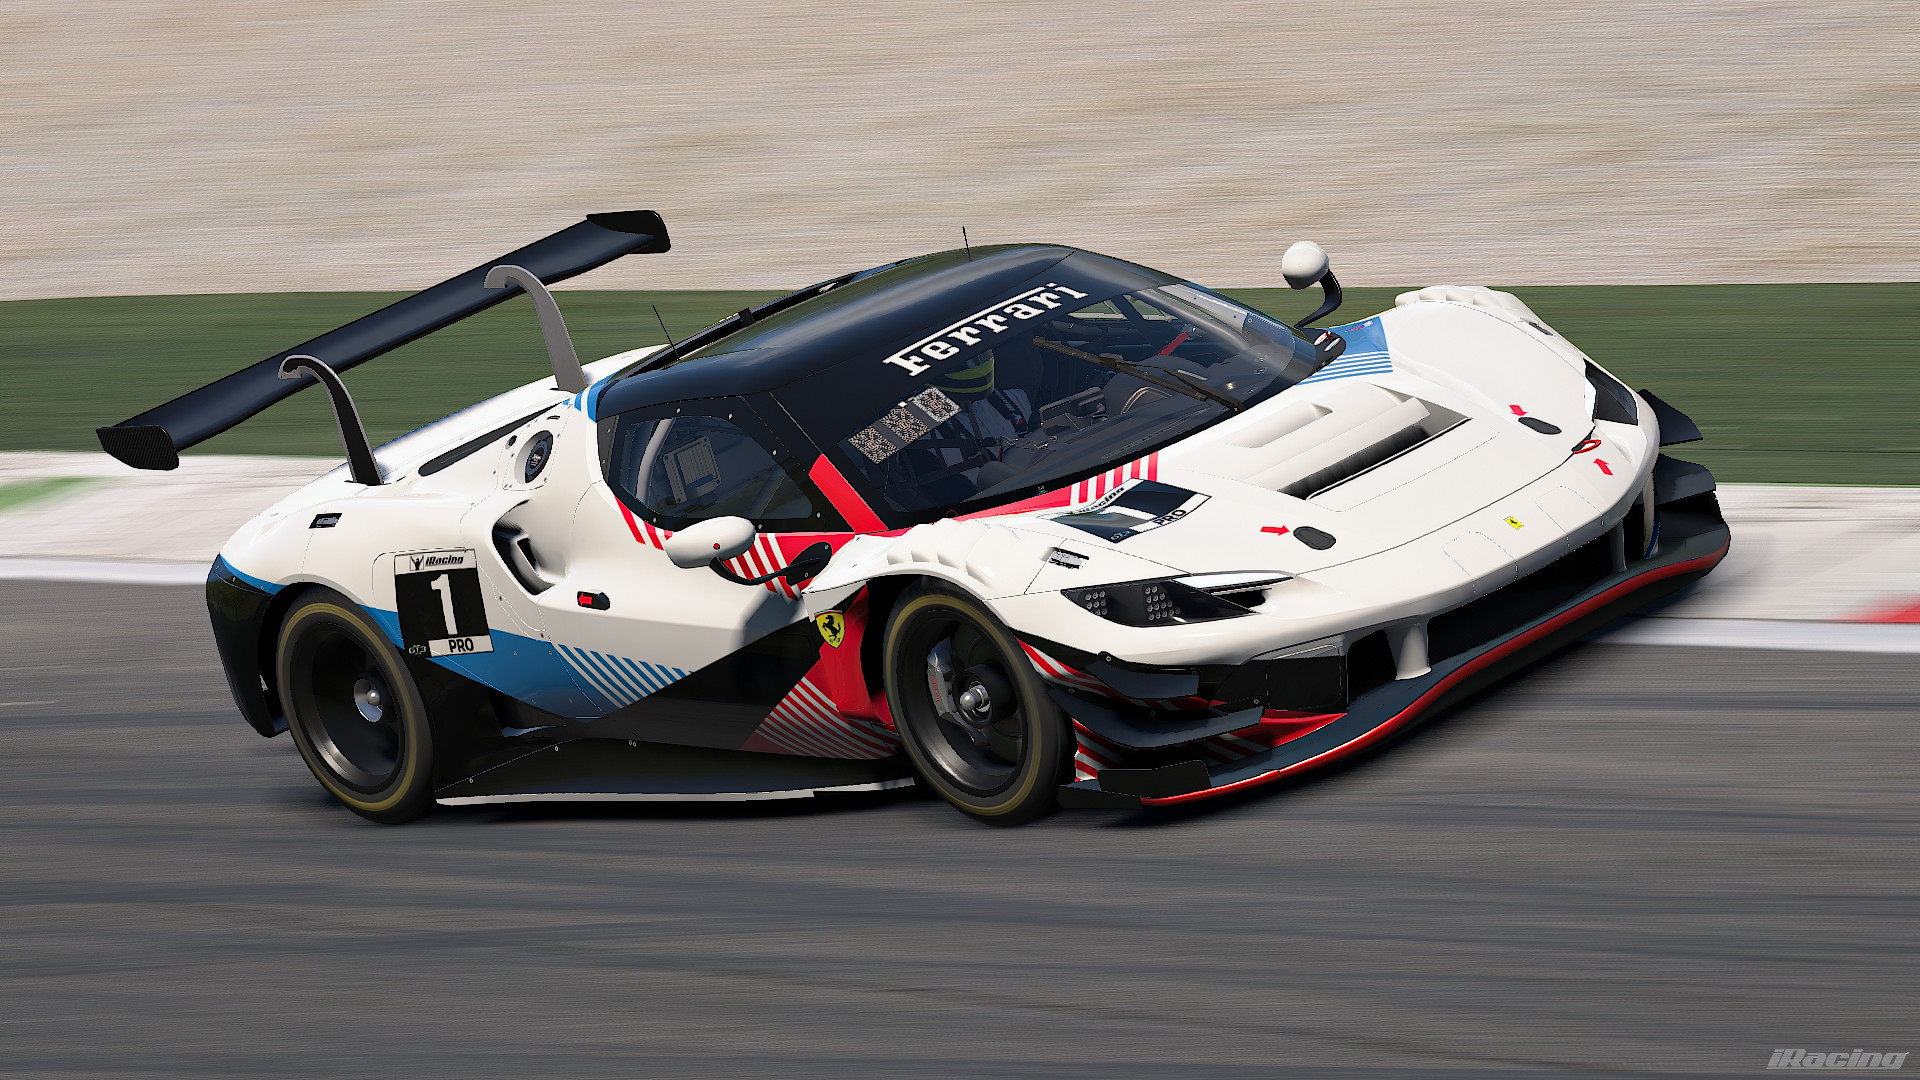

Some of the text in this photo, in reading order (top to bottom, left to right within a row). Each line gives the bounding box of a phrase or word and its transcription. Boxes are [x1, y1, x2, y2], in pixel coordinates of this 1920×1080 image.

[882, 282, 1089, 377] Ferrari
[1153, 509, 1187, 526] PRO
[425, 555, 464, 567] iRacing
[430, 573, 458, 636] 1
[408, 644, 427, 655] GT3
[448, 638, 474, 653] PRO
